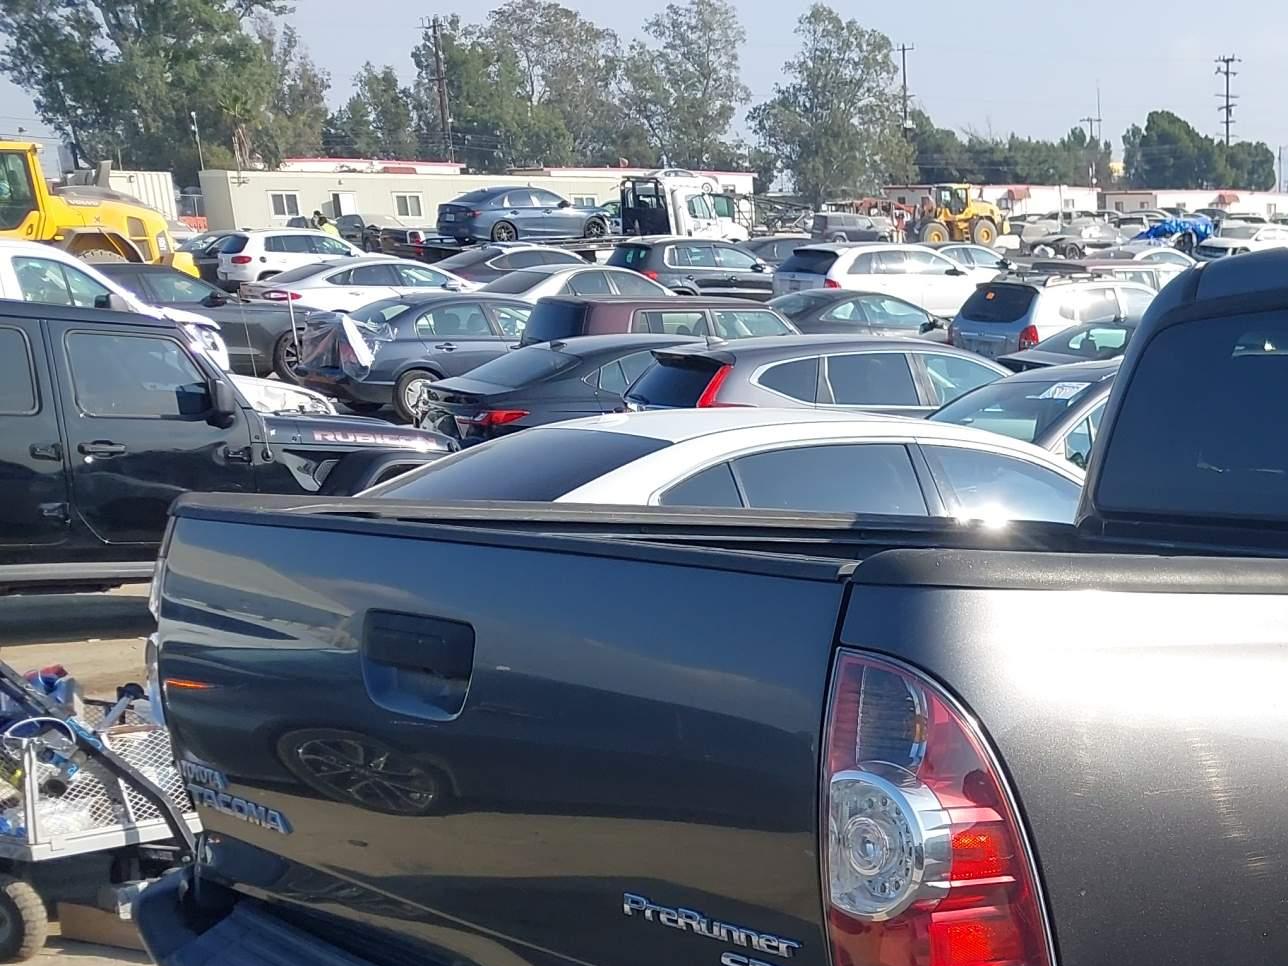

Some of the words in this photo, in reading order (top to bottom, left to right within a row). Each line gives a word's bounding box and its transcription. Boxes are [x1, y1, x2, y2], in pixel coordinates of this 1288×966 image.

[313, 430, 438, 449] RUBICON
[187, 783, 293, 834] TACOMA
[623, 892, 803, 958] PreRunner
